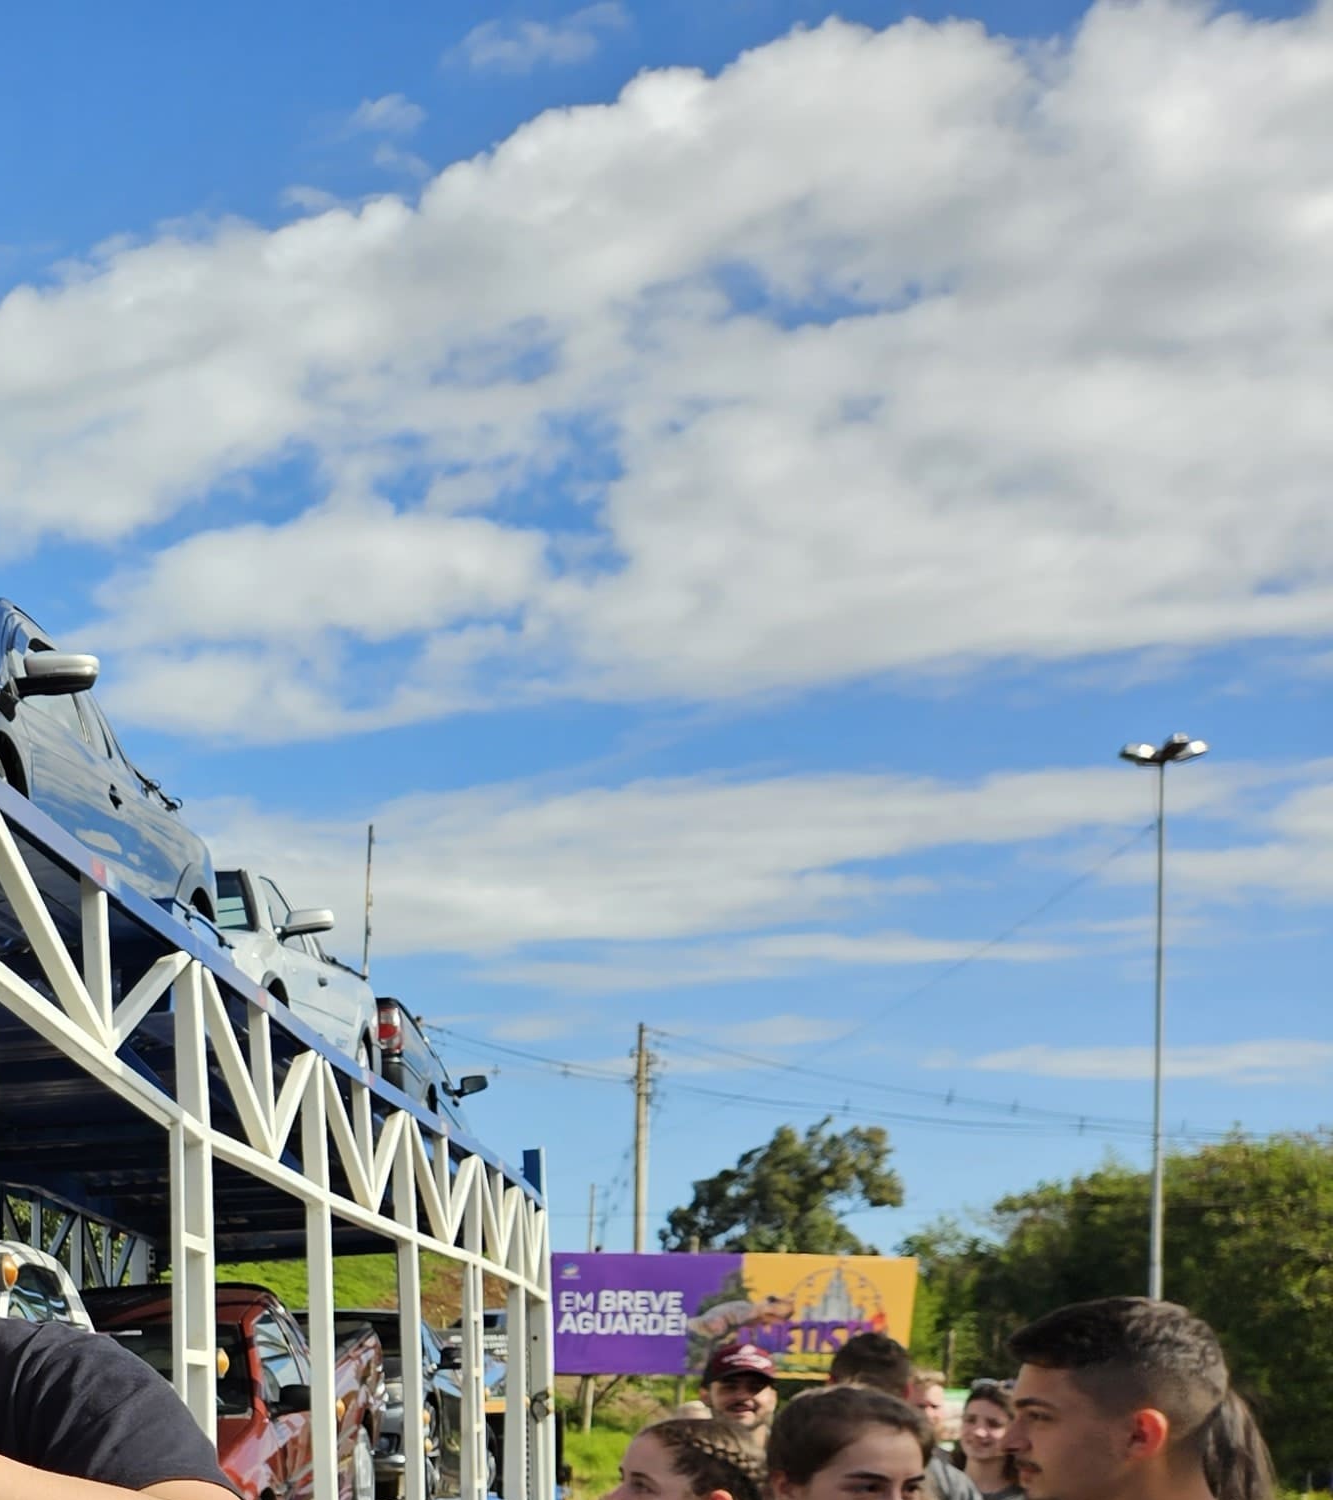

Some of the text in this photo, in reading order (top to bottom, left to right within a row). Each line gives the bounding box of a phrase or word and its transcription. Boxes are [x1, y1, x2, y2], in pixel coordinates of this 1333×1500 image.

[559, 1290, 684, 1313] EM BREVE
[557, 1312, 687, 1336] AGUARDE!
